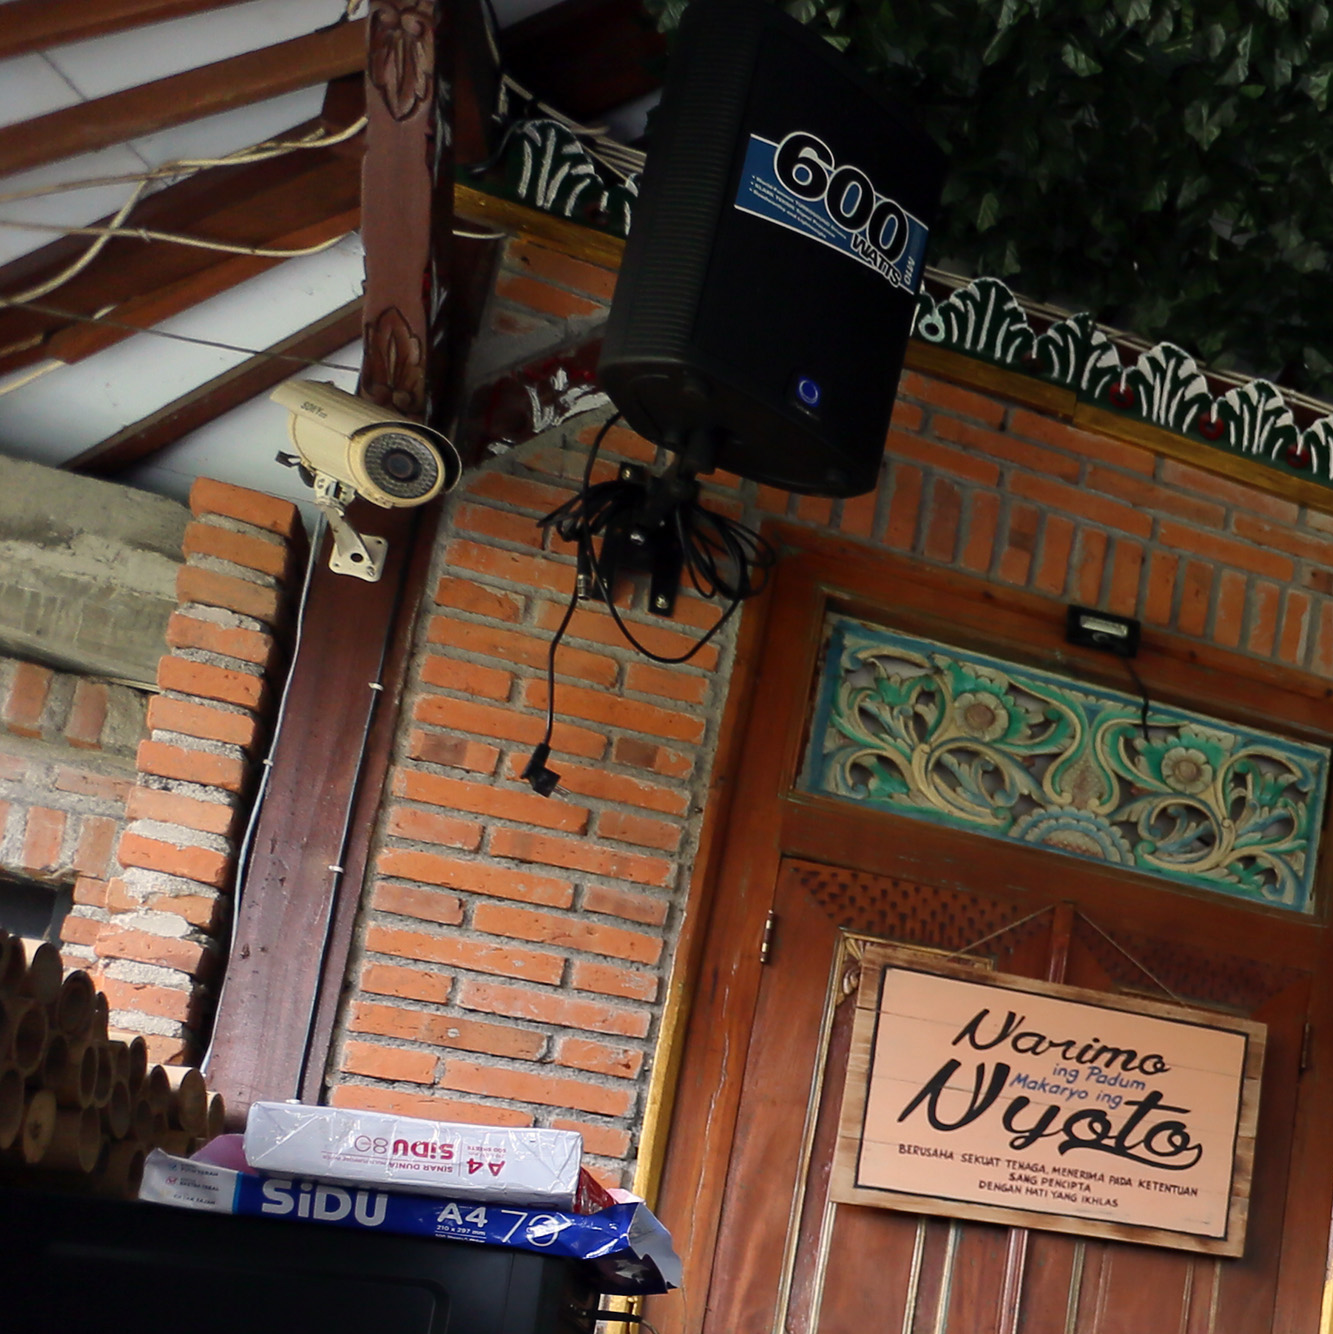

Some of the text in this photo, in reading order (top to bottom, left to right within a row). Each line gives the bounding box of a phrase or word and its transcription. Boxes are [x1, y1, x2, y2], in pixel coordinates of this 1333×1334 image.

[773, 131, 909, 264] 600
[850, 232, 902, 288] WATTS
[952, 1008, 1171, 1075] Narimo
[1009, 1072, 1123, 1109] Makaryo ing
[1052, 1064, 1146, 1091] ing Padum
[897, 1058, 1203, 1170] Nyoto
[423, 1164, 453, 1173] SINAR
[466, 1158, 506, 1176] A4
[898, 1143, 954, 1160] BERUSAHA
[960, 1153, 1001, 1167] SEKUAT
[1051, 1166, 1105, 1182] MENERIMA
[1138, 1179, 1199, 1197] KETENTUAN
[1008, 1172, 1092, 1193] SANG PENCIPTA
[261, 1178, 389, 1227] SiDU
[978, 1180, 1118, 1208] DENGAN HATI YANG IKHLAS
[437, 1203, 488, 1228] A4
